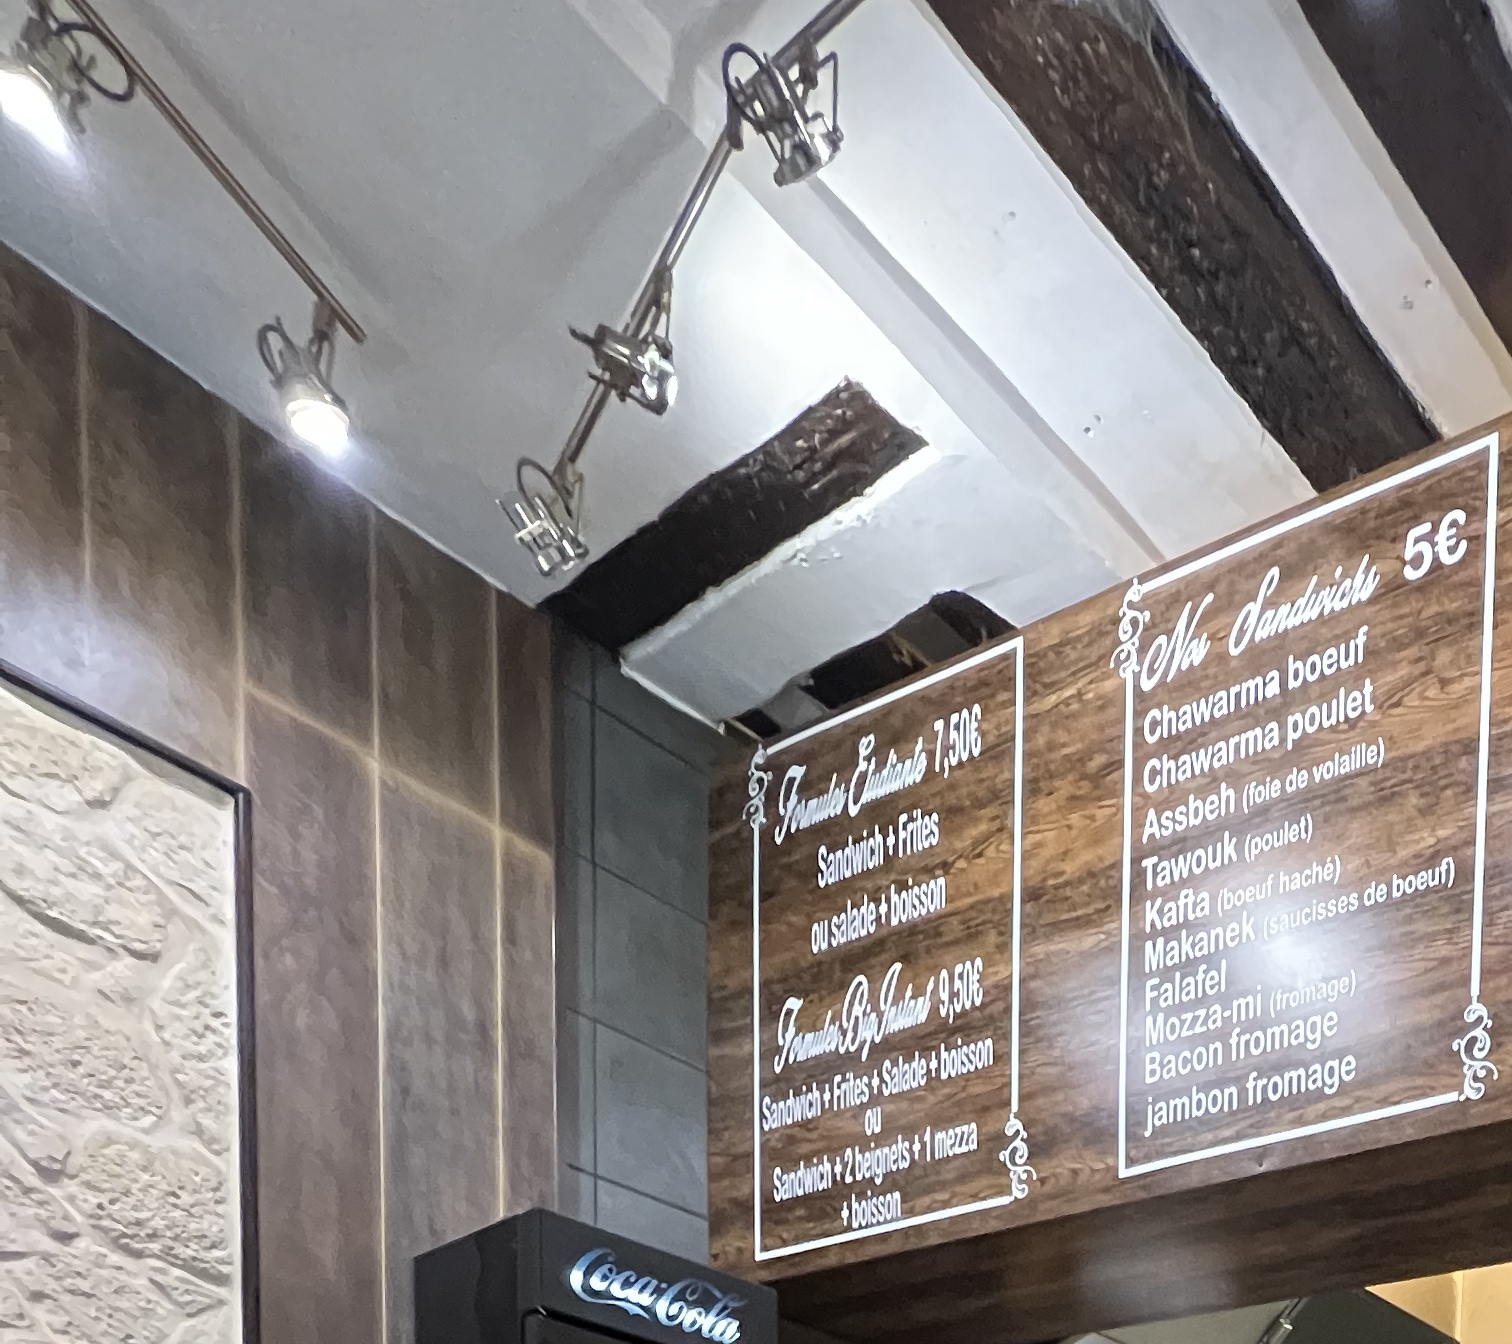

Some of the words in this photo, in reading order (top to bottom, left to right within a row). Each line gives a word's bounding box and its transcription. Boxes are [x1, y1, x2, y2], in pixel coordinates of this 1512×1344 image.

[1139, 592, 1215, 692] Nos
[1402, 508, 1468, 581] 5€
[1143, 667, 1281, 744] Chawarma
[1287, 624, 1369, 690] boeuf
[933, 703, 982, 778] 7,50€
[1143, 719, 1280, 793] Chawarma
[1286, 677, 1375, 750] poulet
[1142, 781, 1236, 844] Assbeh
[1243, 777, 1282, 814] (foie
[1285, 767, 1309, 794] de
[1312, 736, 1386, 783] volaille)
[817, 824, 884, 888] Sandwich
[886, 825, 896, 856] +
[898, 808, 939, 858] Frites
[1141, 830, 1238, 891] Tawouk
[1244, 813, 1314, 863] (poulet)
[811, 919, 828, 954] ou
[830, 894, 877, 948] salade
[879, 893, 888, 924] +
[890, 876, 946, 927] boisson
[1143, 911, 1256, 974] Makanek
[1263, 890, 1360, 941] (saucisses
[1363, 881, 1388, 908] de
[1392, 857, 1456, 898] boeuf)
[1144, 887, 1211, 934] Kafta
[1216, 873, 1274, 917] (boeuf
[1278, 855, 1341, 895] haché)
[938, 956, 983, 1024] 9,50€
[1144, 959, 1227, 1012] Falafel
[1144, 985, 1263, 1048] Mozza-mi
[1268, 968, 1357, 1019] (fromage)
[761, 1082, 821, 1132] Sandwich
[823, 1083, 831, 1109] +
[833, 1072, 869, 1111] Frites
[871, 1069, 880, 1095] +
[881, 1051, 927, 1096] Salade
[929, 1050, 939, 1078] +
[940, 1037, 994, 1080] boisson
[1144, 1039, 1223, 1085] Bacon
[1229, 1010, 1340, 1063] fromage
[864, 1106, 882, 1136] ou
[1143, 1075, 1239, 1138] jambon
[1246, 1053, 1357, 1108] fromage
[772, 1154, 832, 1202] Sandwich
[833, 1156, 842, 1182] +
[844, 1147, 854, 1185] 2
[854, 1134, 911, 1186] beignets
[912, 1134, 921, 1160] +
[923, 1125, 931, 1162] 1
[934, 1121, 978, 1160] mezza
[840, 1201, 849, 1227] +
[851, 1190, 901, 1229] boisson
[569, 1248, 746, 1344] Coca-Cola
